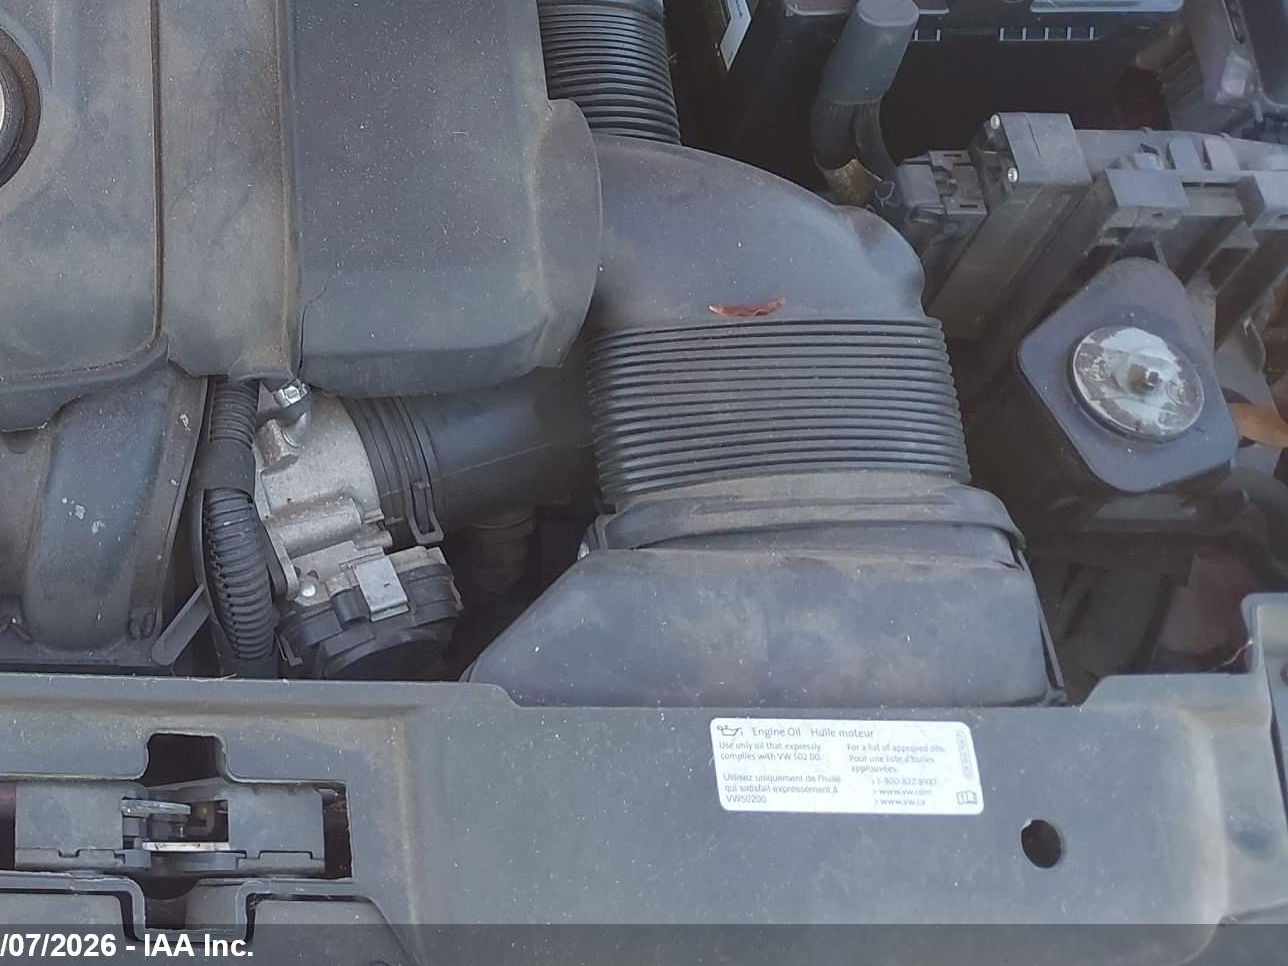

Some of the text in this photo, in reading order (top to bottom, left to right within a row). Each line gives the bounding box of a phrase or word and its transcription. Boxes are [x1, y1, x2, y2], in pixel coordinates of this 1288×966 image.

[752, 727, 873, 739] Engine Oil Huile moteur
